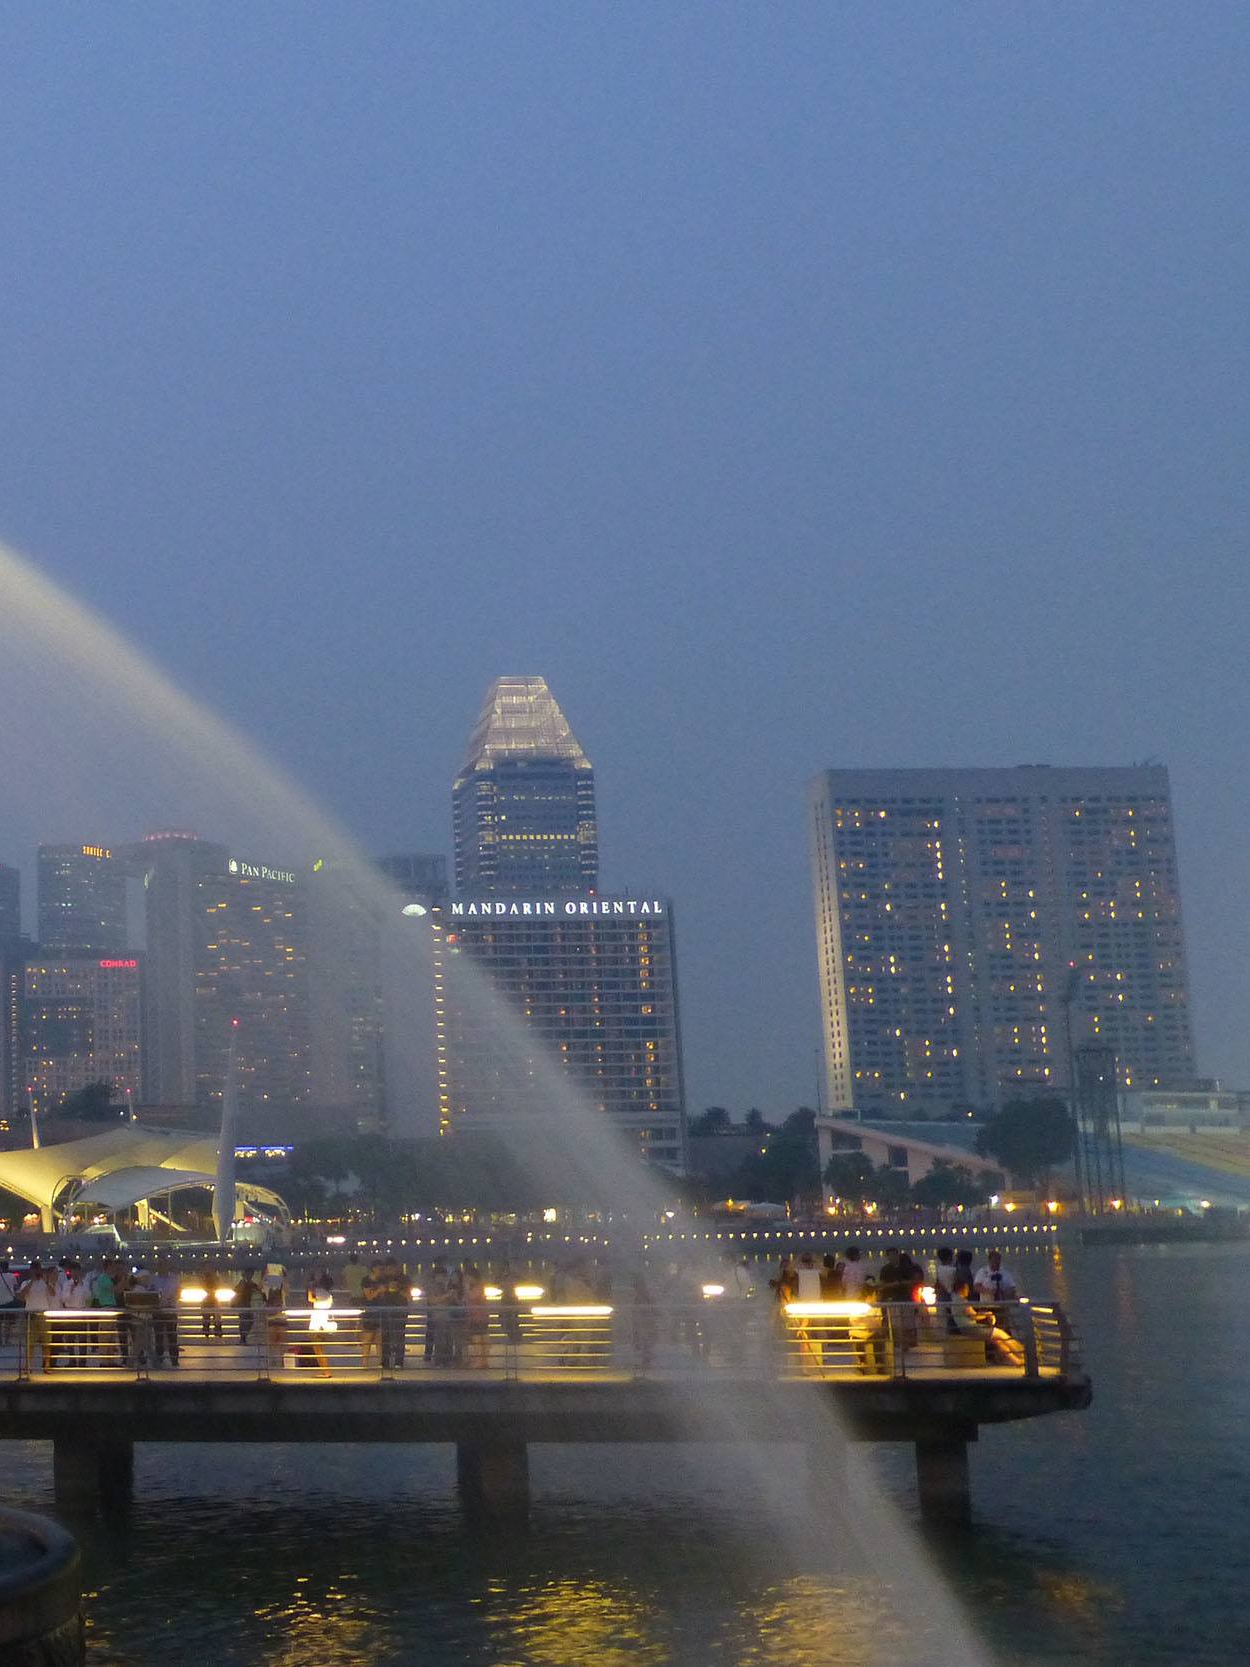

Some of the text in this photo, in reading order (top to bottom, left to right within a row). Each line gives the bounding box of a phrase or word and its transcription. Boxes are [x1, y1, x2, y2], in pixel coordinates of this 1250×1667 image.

[241, 863, 295, 883] PAN PACIFIC
[451, 901, 662, 915] MANDARIN ORIENTAL
[99, 959, 137, 968] CONRAD
